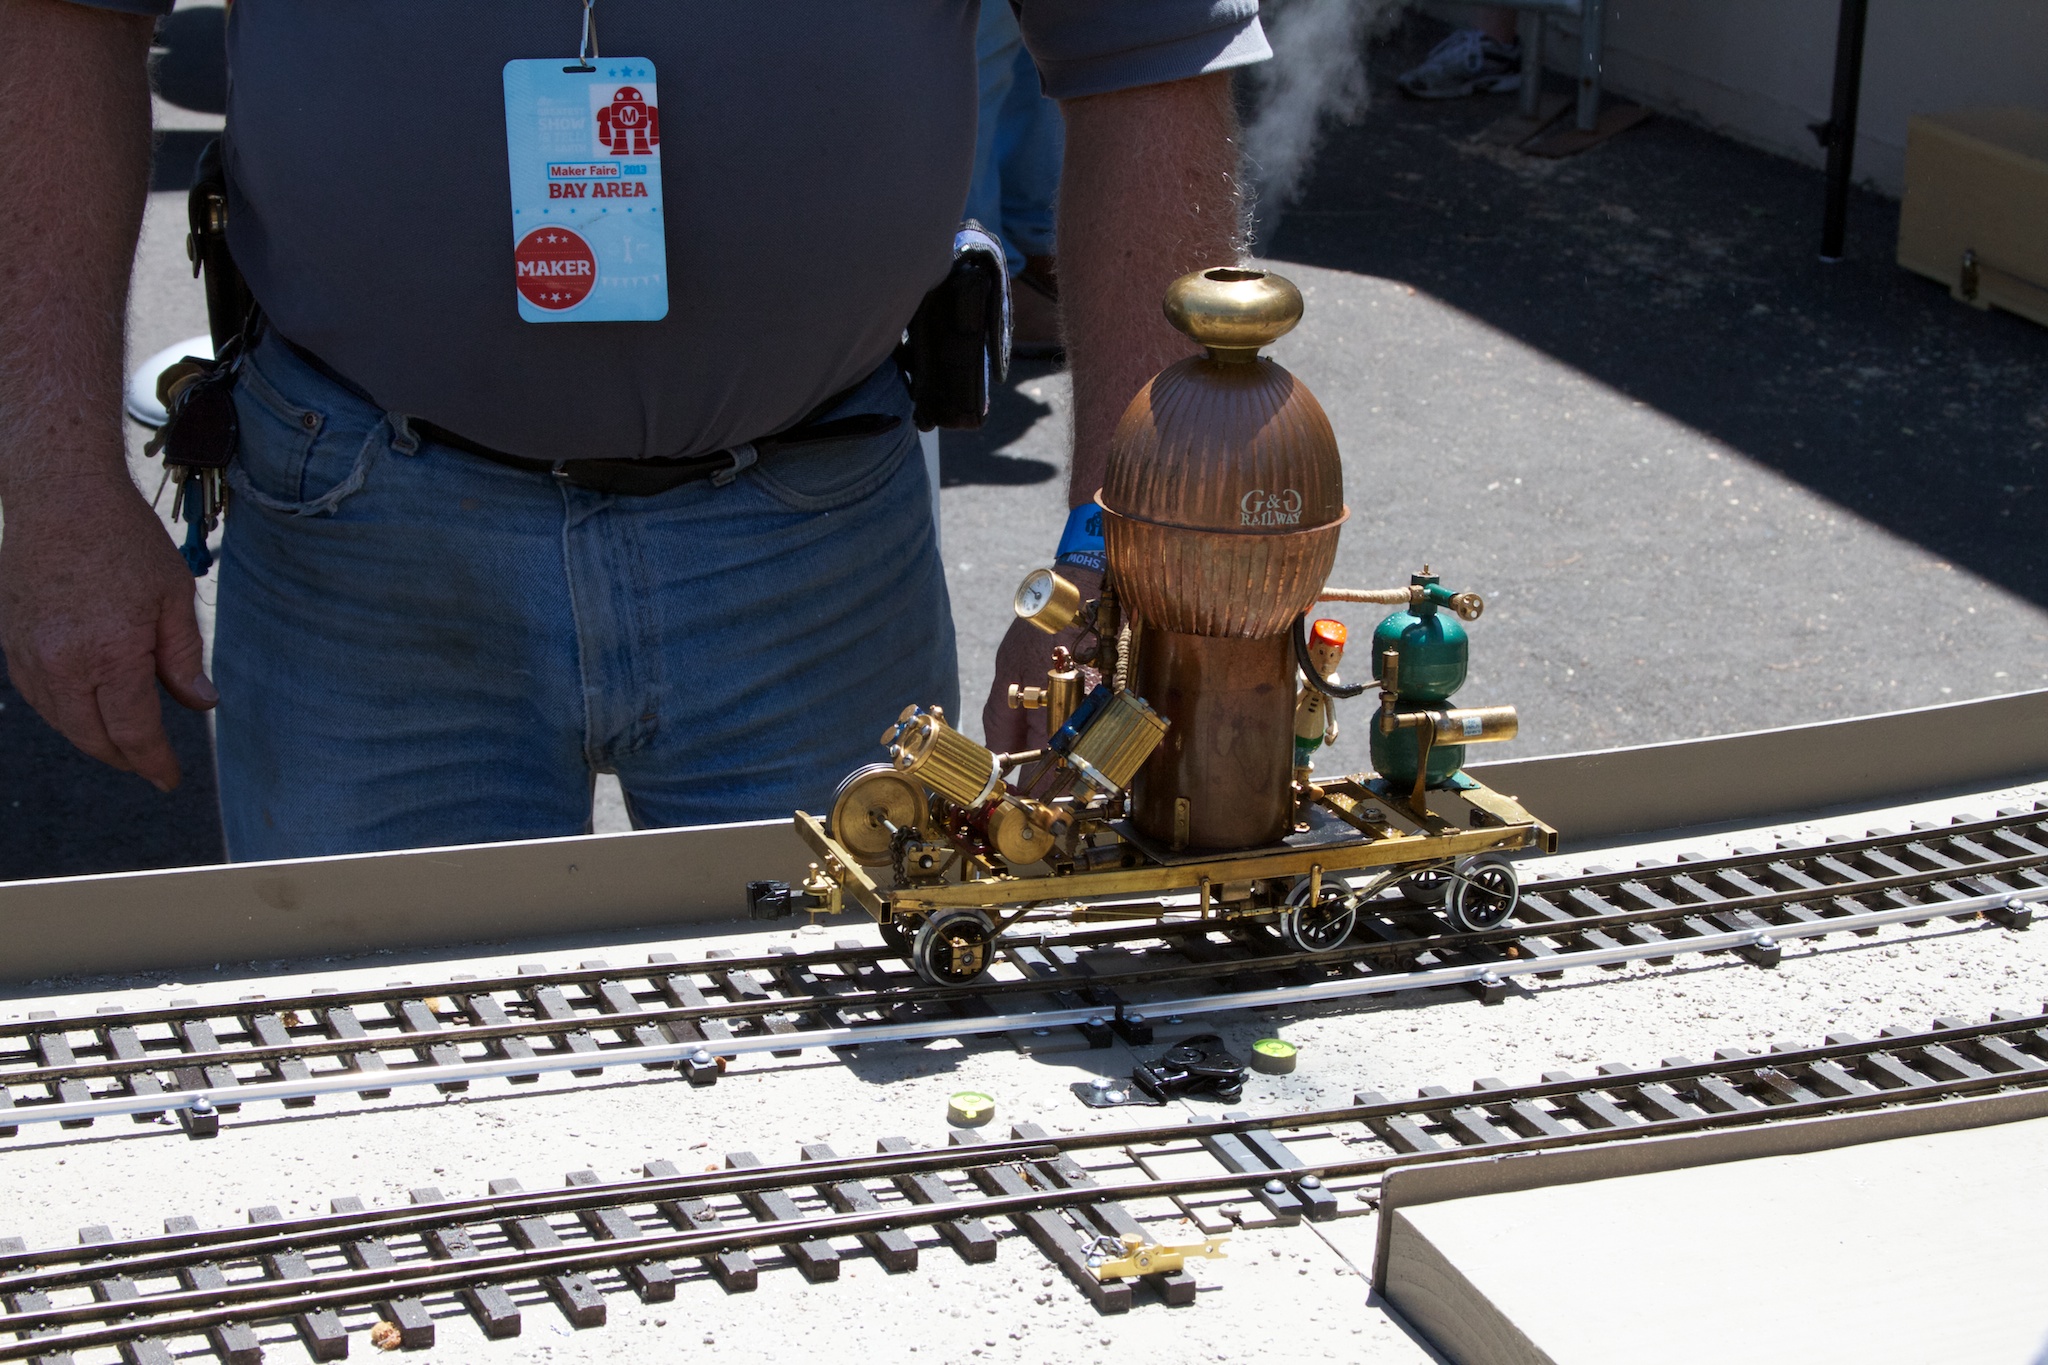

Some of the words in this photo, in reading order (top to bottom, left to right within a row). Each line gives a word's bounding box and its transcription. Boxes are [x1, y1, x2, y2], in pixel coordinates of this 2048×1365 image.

[623, 109, 636, 123] M
[538, 117, 586, 131] SHOW
[551, 166, 587, 176] Maker
[590, 165, 618, 176] Faire
[624, 164, 648, 175] 2013
[549, 183, 588, 199] BAY
[592, 182, 649, 198] AREA
[517, 259, 592, 278] MAKER
[1240, 509, 1303, 526] RAILWAY
